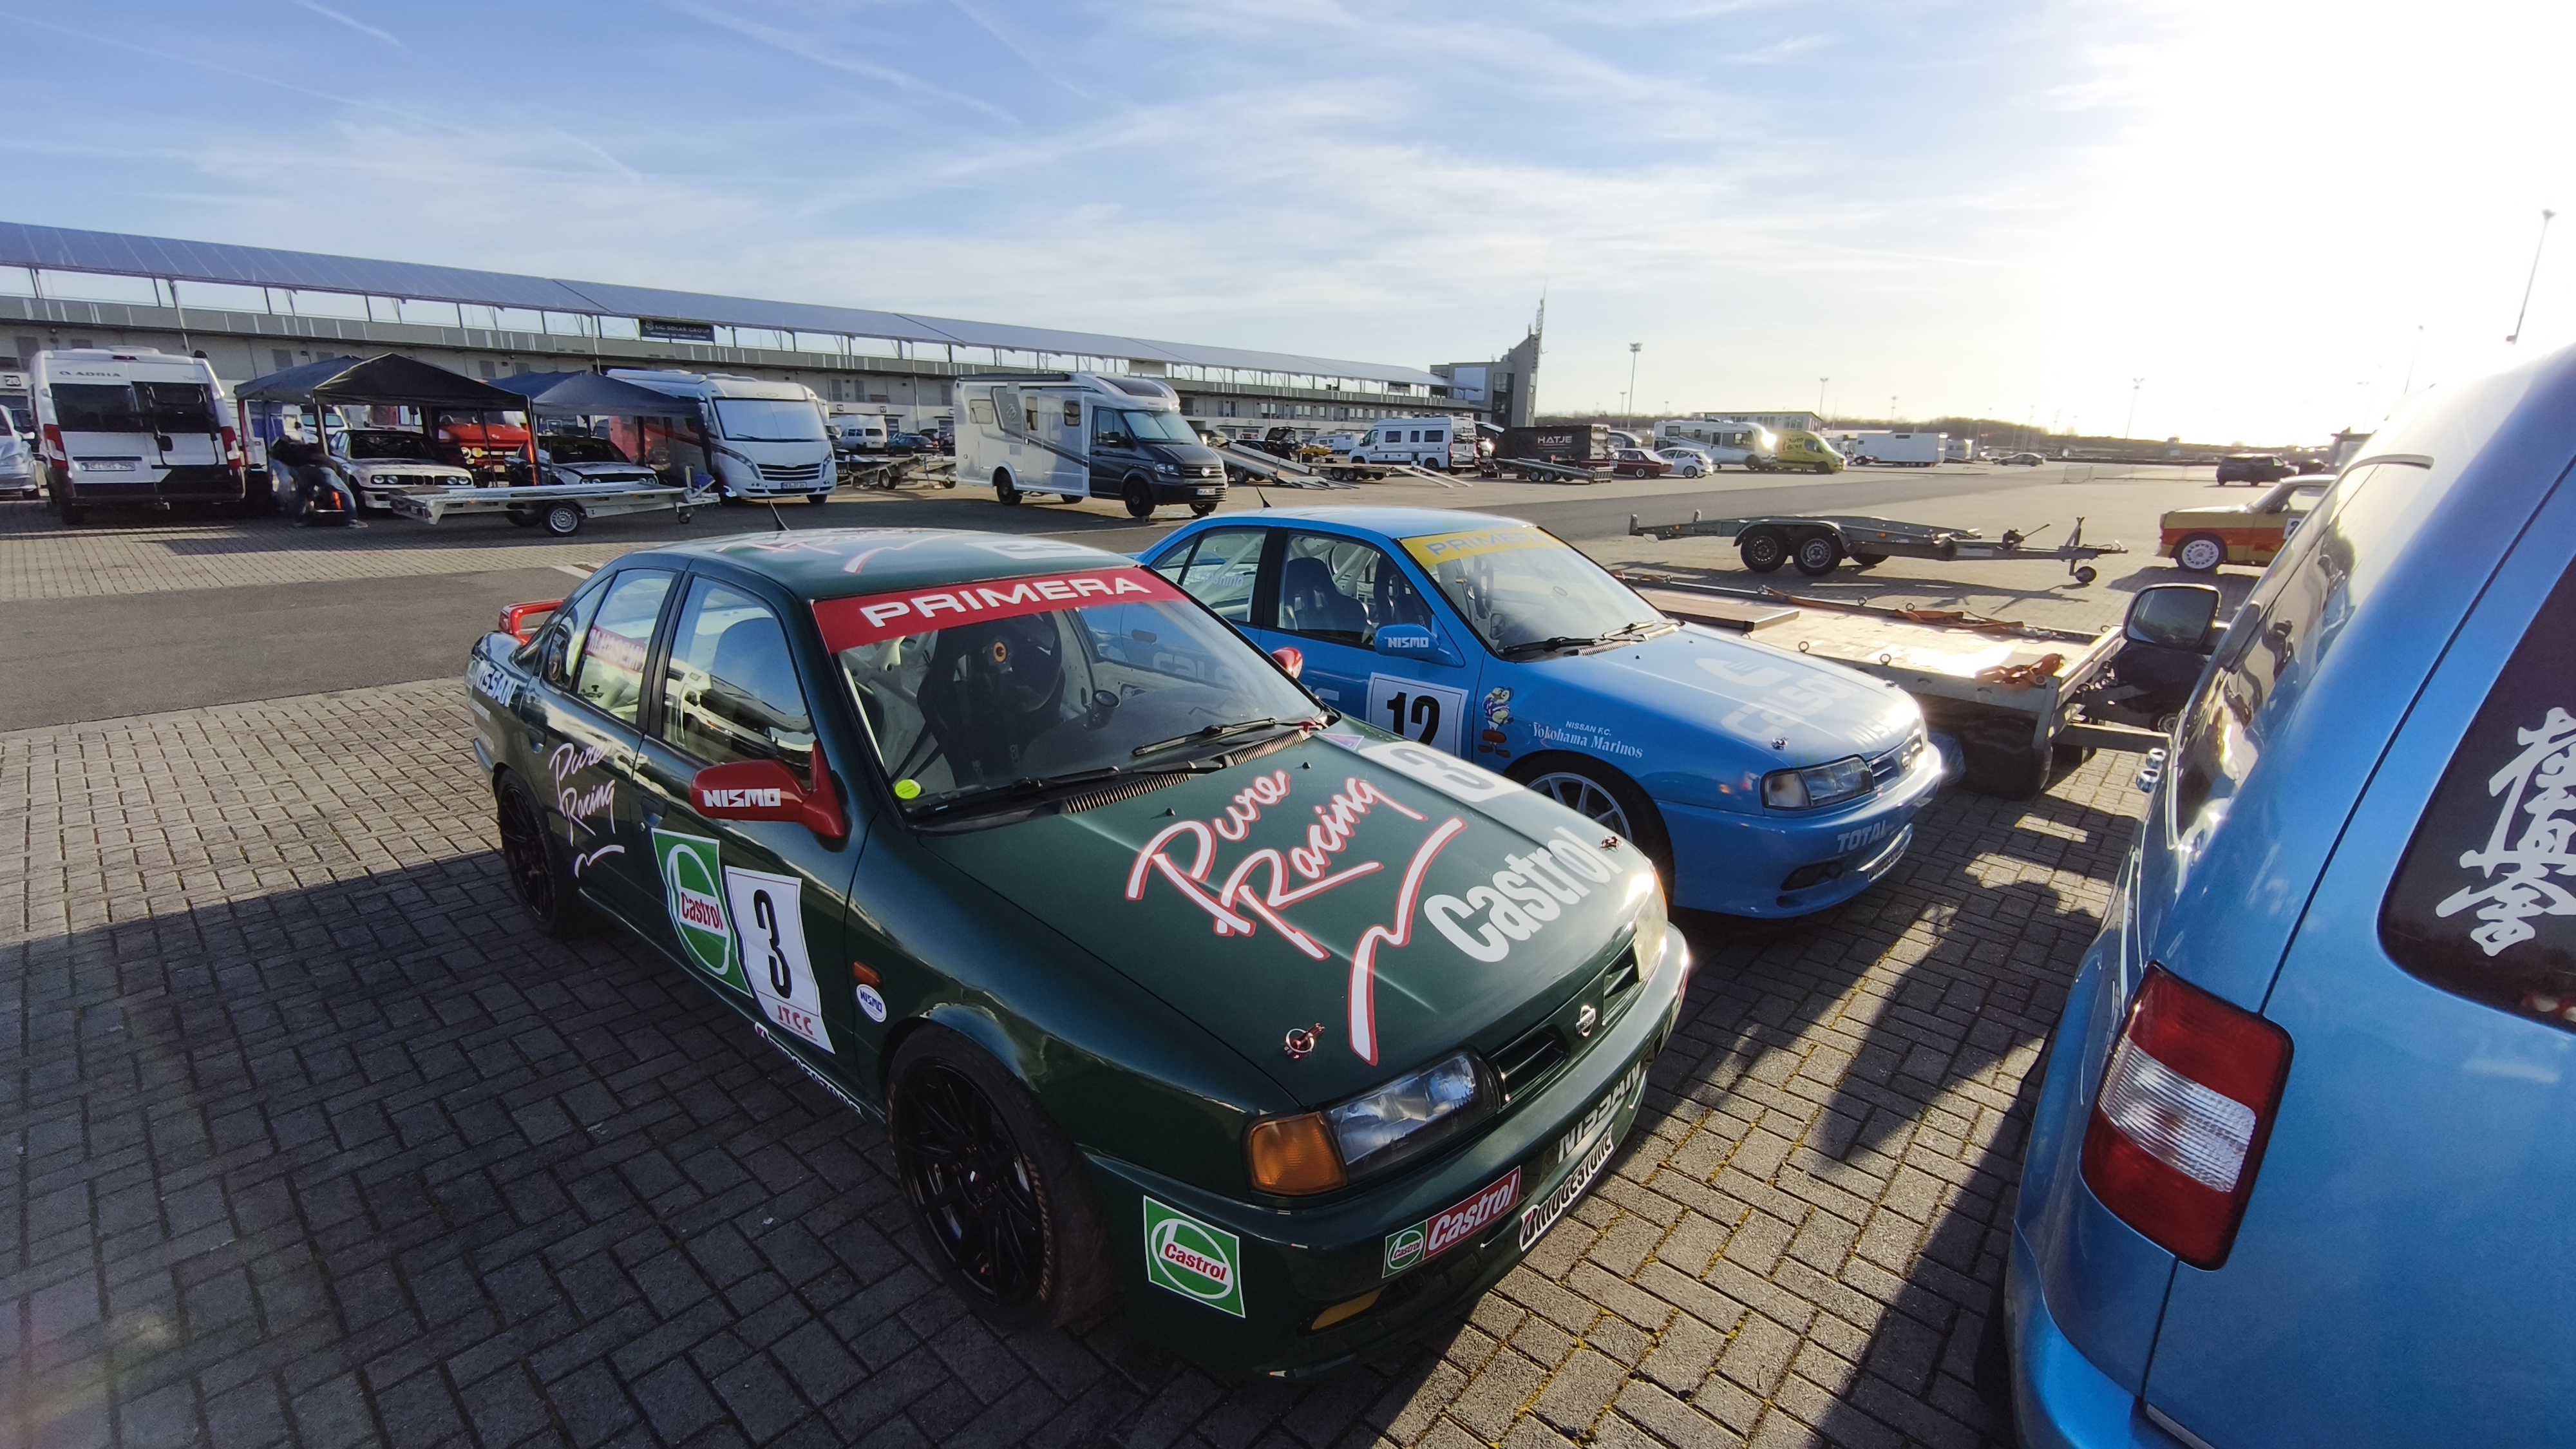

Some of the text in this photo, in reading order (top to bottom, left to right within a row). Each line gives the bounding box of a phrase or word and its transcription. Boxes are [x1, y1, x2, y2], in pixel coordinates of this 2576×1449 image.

[5, 376, 21, 385] 26
[1537, 435, 1573, 444] HATJE
[1425, 532, 1551, 556] PRIMERA
[860, 577, 1152, 629] PRIMERA
[1387, 637, 1429, 649] NISMO
[1387, 691, 1440, 746] 12
[1566, 720, 1596, 734] NISSAN
[1532, 721, 1643, 759] Yokohama Marinos
[549, 742, 609, 817] Pure
[1388, 744, 1487, 791] 3
[558, 779, 616, 848] Racing
[703, 788, 781, 808] NISMO
[1125, 770, 1290, 937] Pure
[1213, 776, 1428, 960] Racing
[680, 891, 724, 931] Castrol
[1423, 826, 1624, 963] Castrol
[753, 889, 793, 999] 3
[777, 1005, 813, 1036] JTCC
[860, 989, 883, 1014] NISMO
[1558, 1059, 1642, 1165] NISSAN
[1428, 1172, 1518, 1251] Castrol
[1164, 1243, 1227, 1282] Castrol
[1393, 1237, 1422, 1259] Castrol
